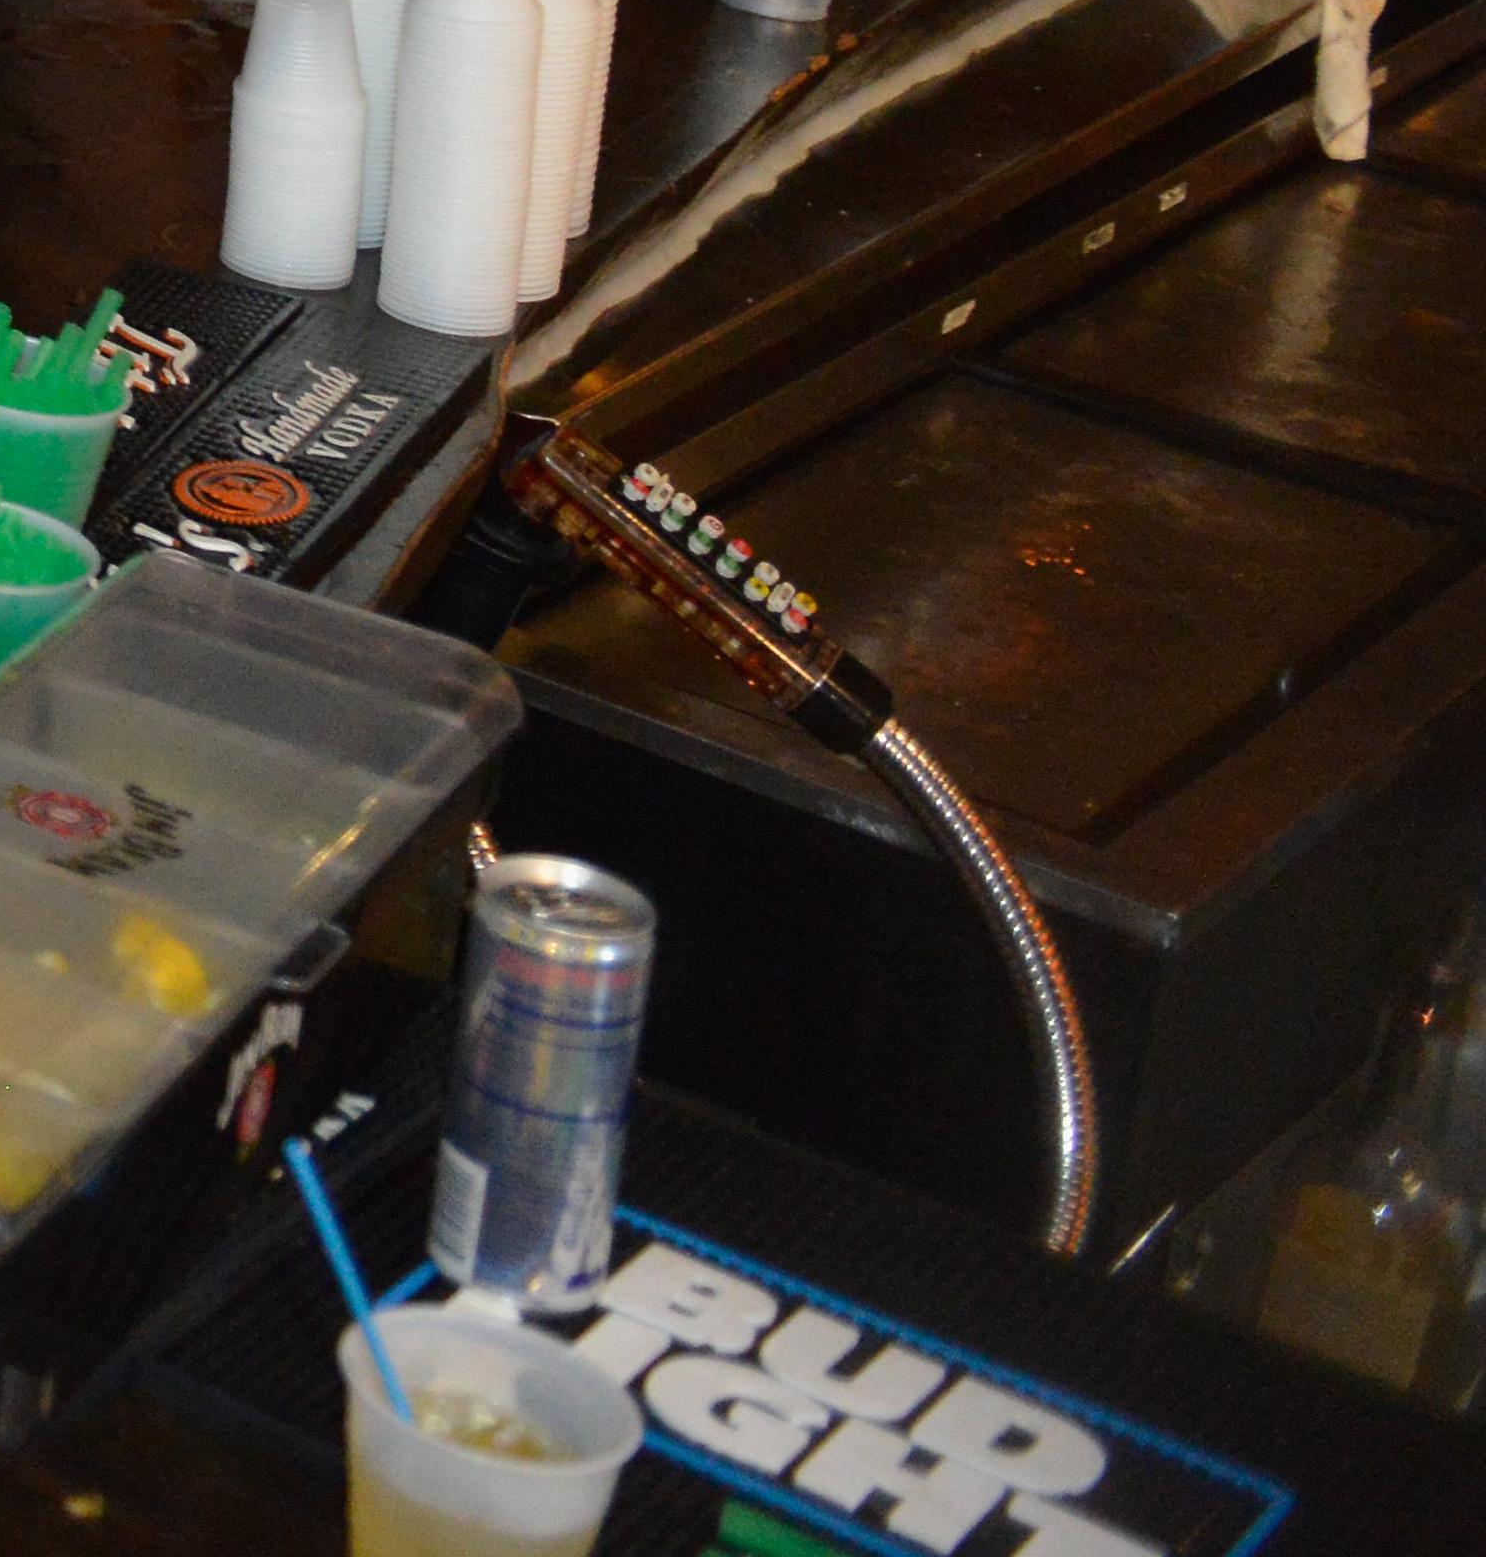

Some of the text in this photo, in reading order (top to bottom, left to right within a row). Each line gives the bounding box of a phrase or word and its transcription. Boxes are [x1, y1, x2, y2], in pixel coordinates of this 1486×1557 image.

[234, 361, 360, 463] Handmade
[306, 392, 399, 461] VODKA
[447, 1290, 1157, 1557] IGHT
[597, 1242, 1109, 1499] BUD
